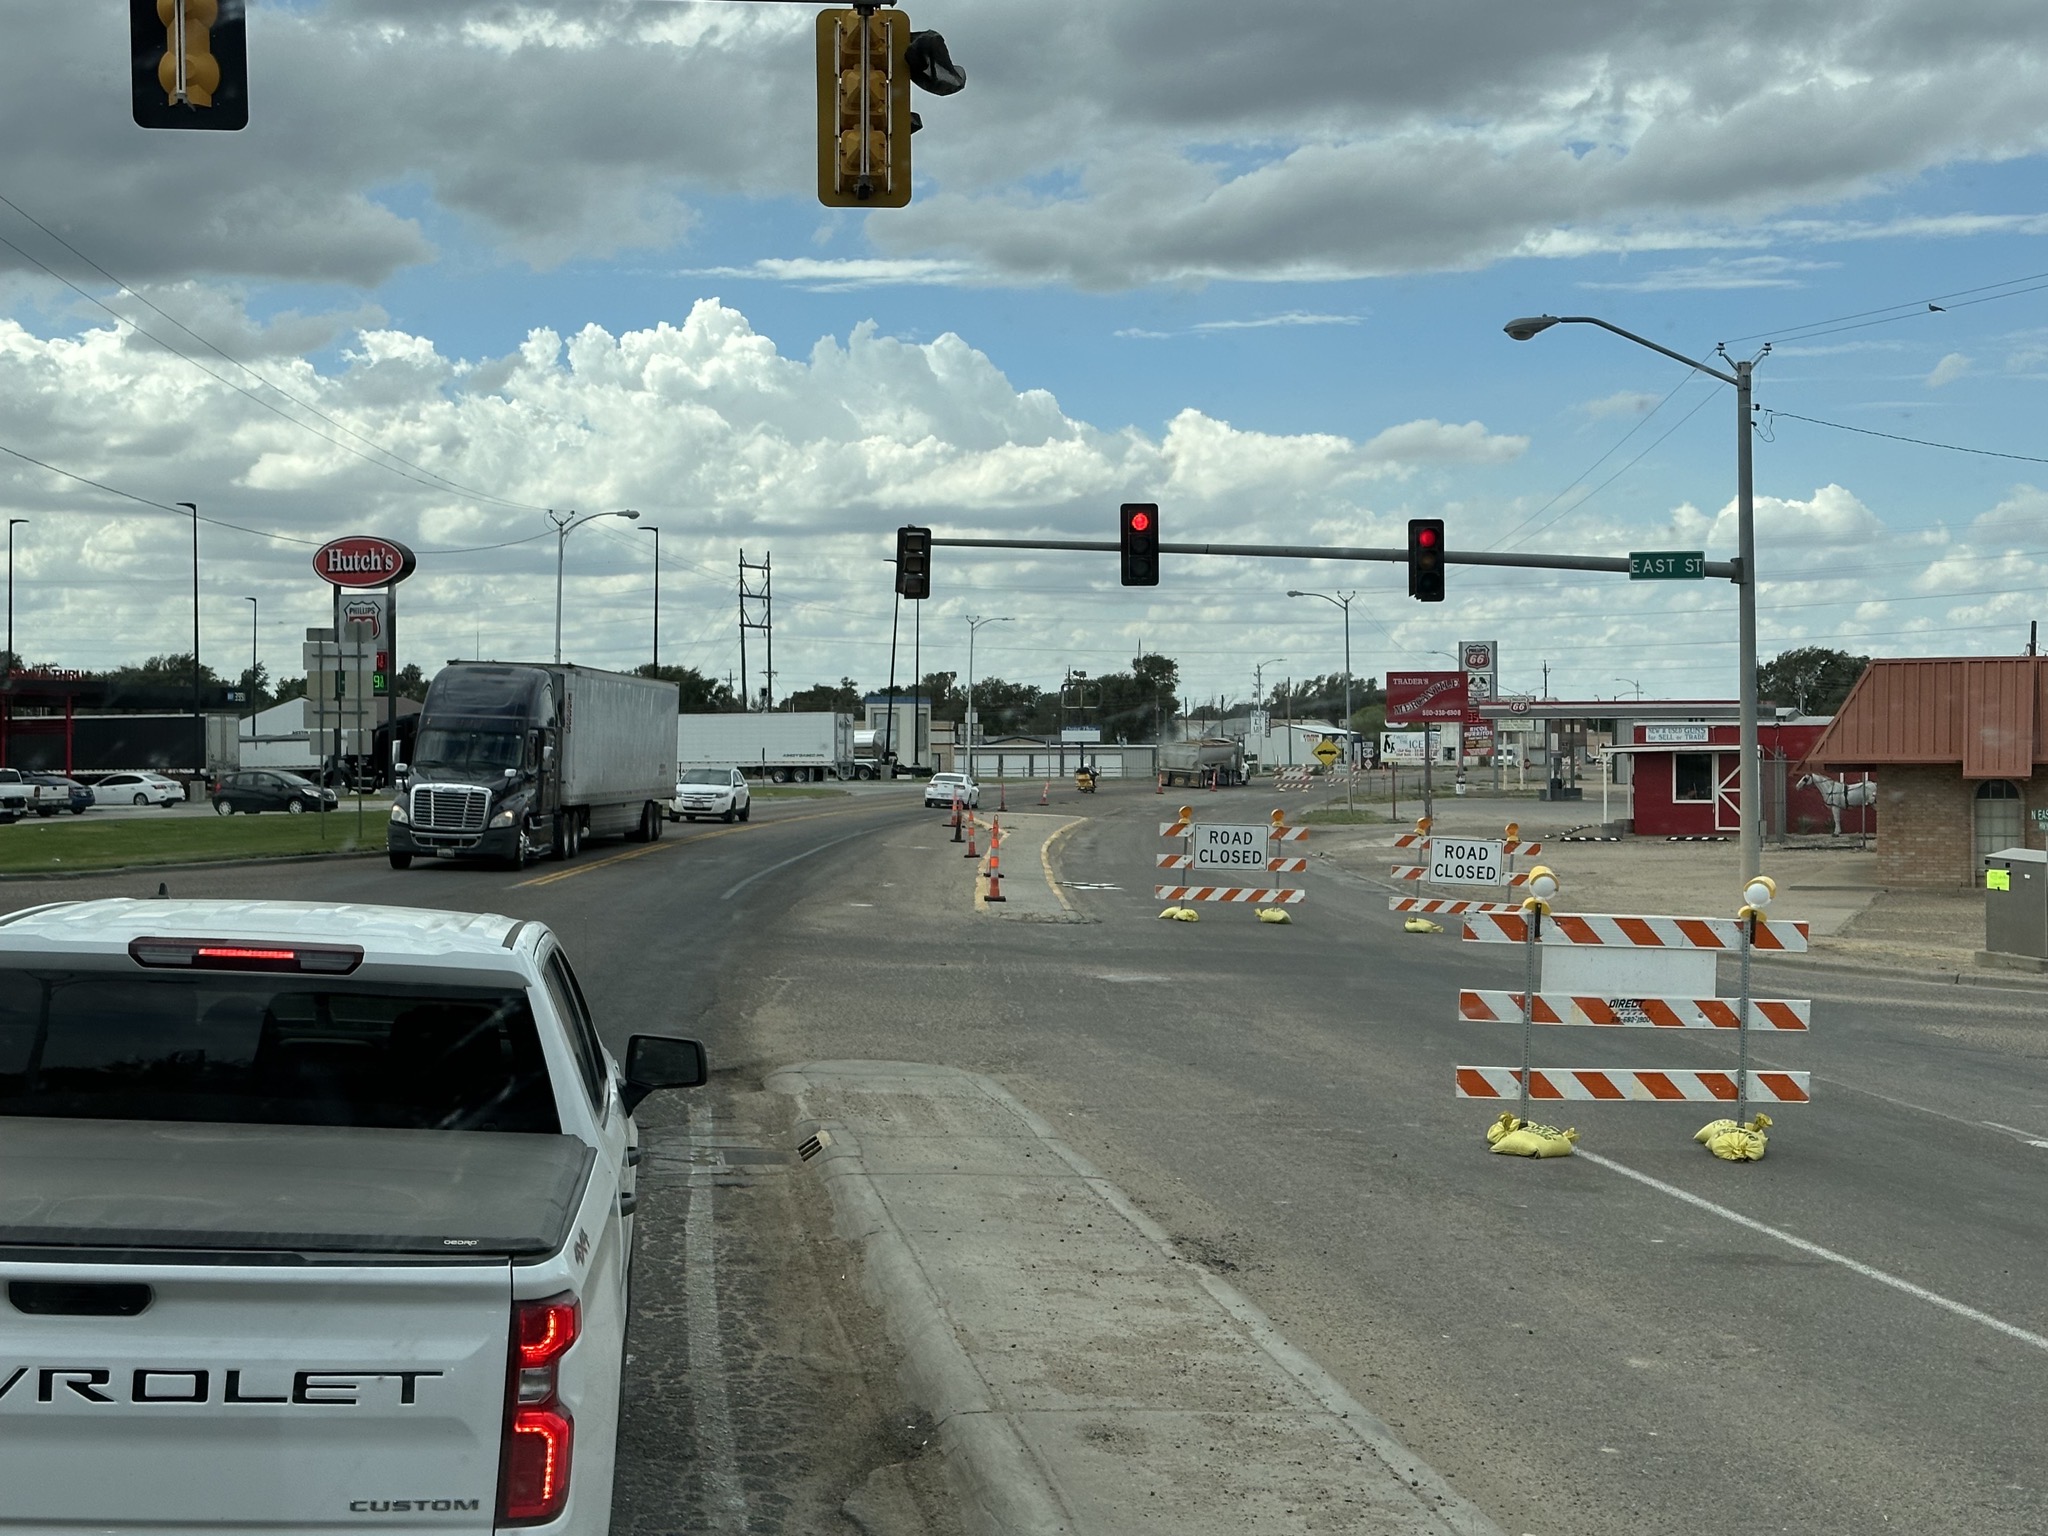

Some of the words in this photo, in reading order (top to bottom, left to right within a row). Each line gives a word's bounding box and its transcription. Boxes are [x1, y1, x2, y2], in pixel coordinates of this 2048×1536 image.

[327, 547, 394, 572] Hutch's
[1631, 558, 1676, 574] EAST
[1685, 558, 1703, 573] ST
[348, 606, 376, 615] PHILLIPS
[1469, 654, 1485, 664] 66
[51, 668, 85, 681] THRU
[1393, 678, 1460, 714] MERCANTILE
[1512, 702, 1526, 711] 66
[1409, 740, 1424, 749] ICE
[2031, 809, 2037, 821] N
[1209, 830, 1253, 846] ROAD
[1199, 848, 1262, 865] CLOSED
[1444, 844, 1488, 861] ROAD
[1434, 863, 1496, 880] CLOSED
[1609, 998, 1646, 1009] DIRECT
[349, 1499, 479, 1512] CUSTOM
